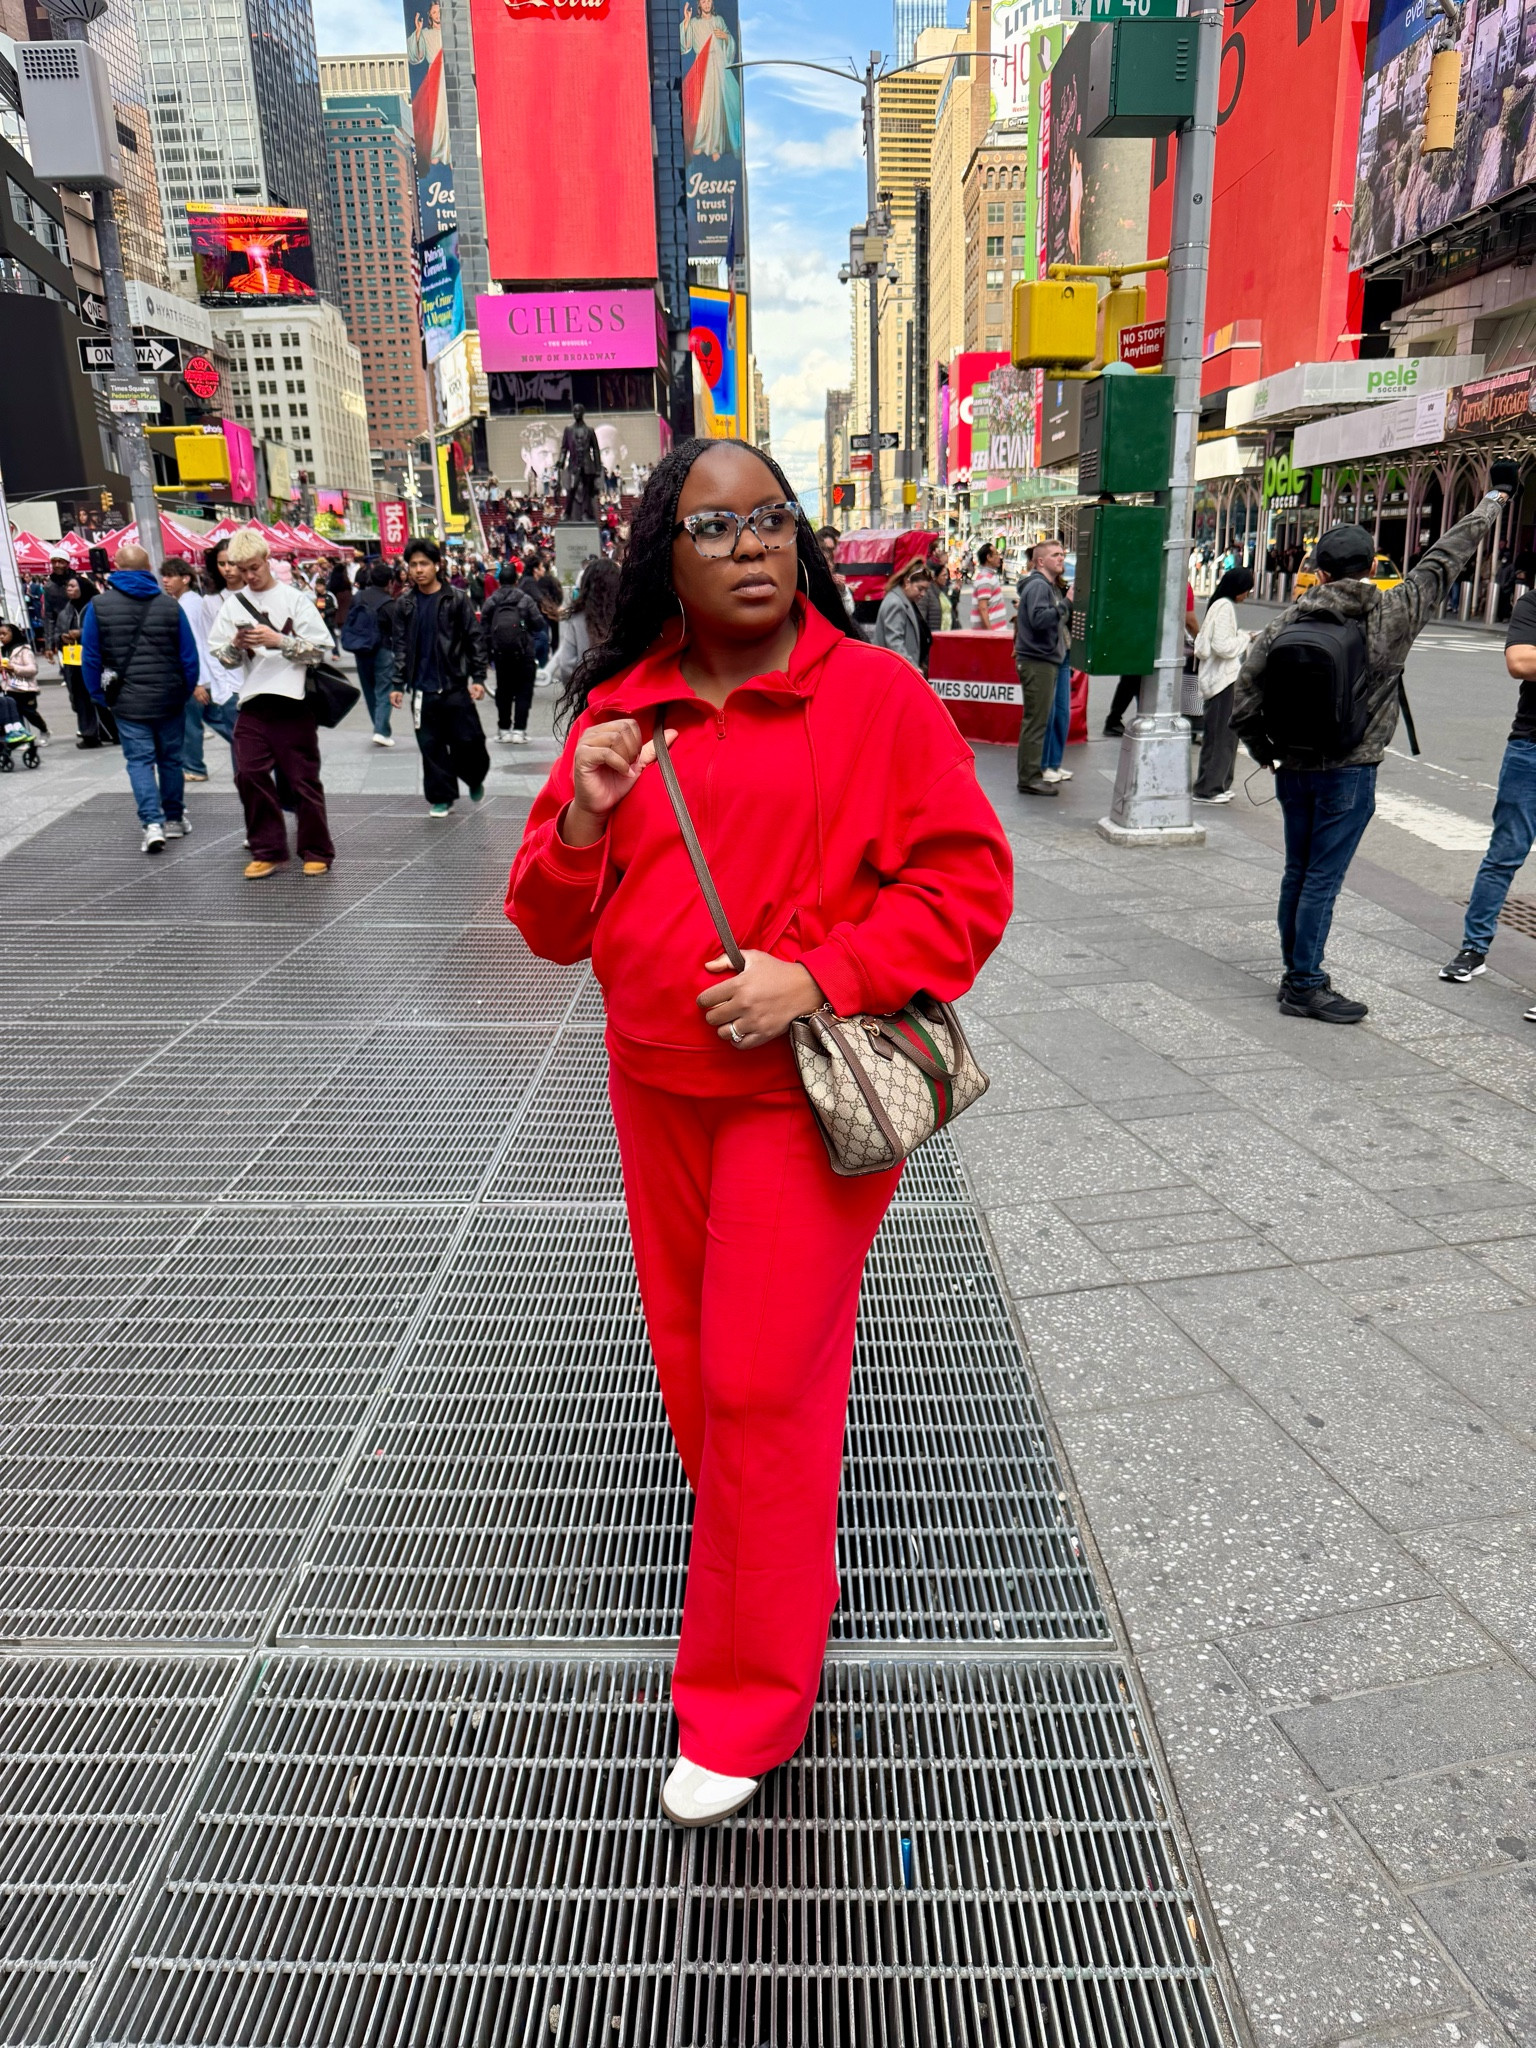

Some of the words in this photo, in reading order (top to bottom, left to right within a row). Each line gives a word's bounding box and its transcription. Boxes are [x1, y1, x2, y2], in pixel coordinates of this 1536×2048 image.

[687, 172, 736, 198] Jesus
[696, 199, 700, 210] I
[701, 199, 726, 210] trust
[696, 211, 707, 223] in
[709, 213, 728, 225] you
[88, 302, 103, 319] ONE
[156, 304, 178, 322] HYATT
[508, 304, 625, 335] CHESS
[1123, 333, 1136, 345] NO
[95, 349, 113, 361] ON
[521, 354, 543, 363] NOW
[547, 353, 560, 362] ON
[563, 352, 616, 361] BROADWAY
[1123, 343, 1160, 359] Anytime
[1367, 359, 1419, 393] pelé
[128, 385, 150, 393] Square
[1377, 386, 1407, 394] SOCCER
[1459, 400, 1482, 427] GIFTS
[1271, 495, 1299, 509] SOCCER
[384, 504, 404, 543] tkts
[963, 684, 1015, 701] SQUARE
